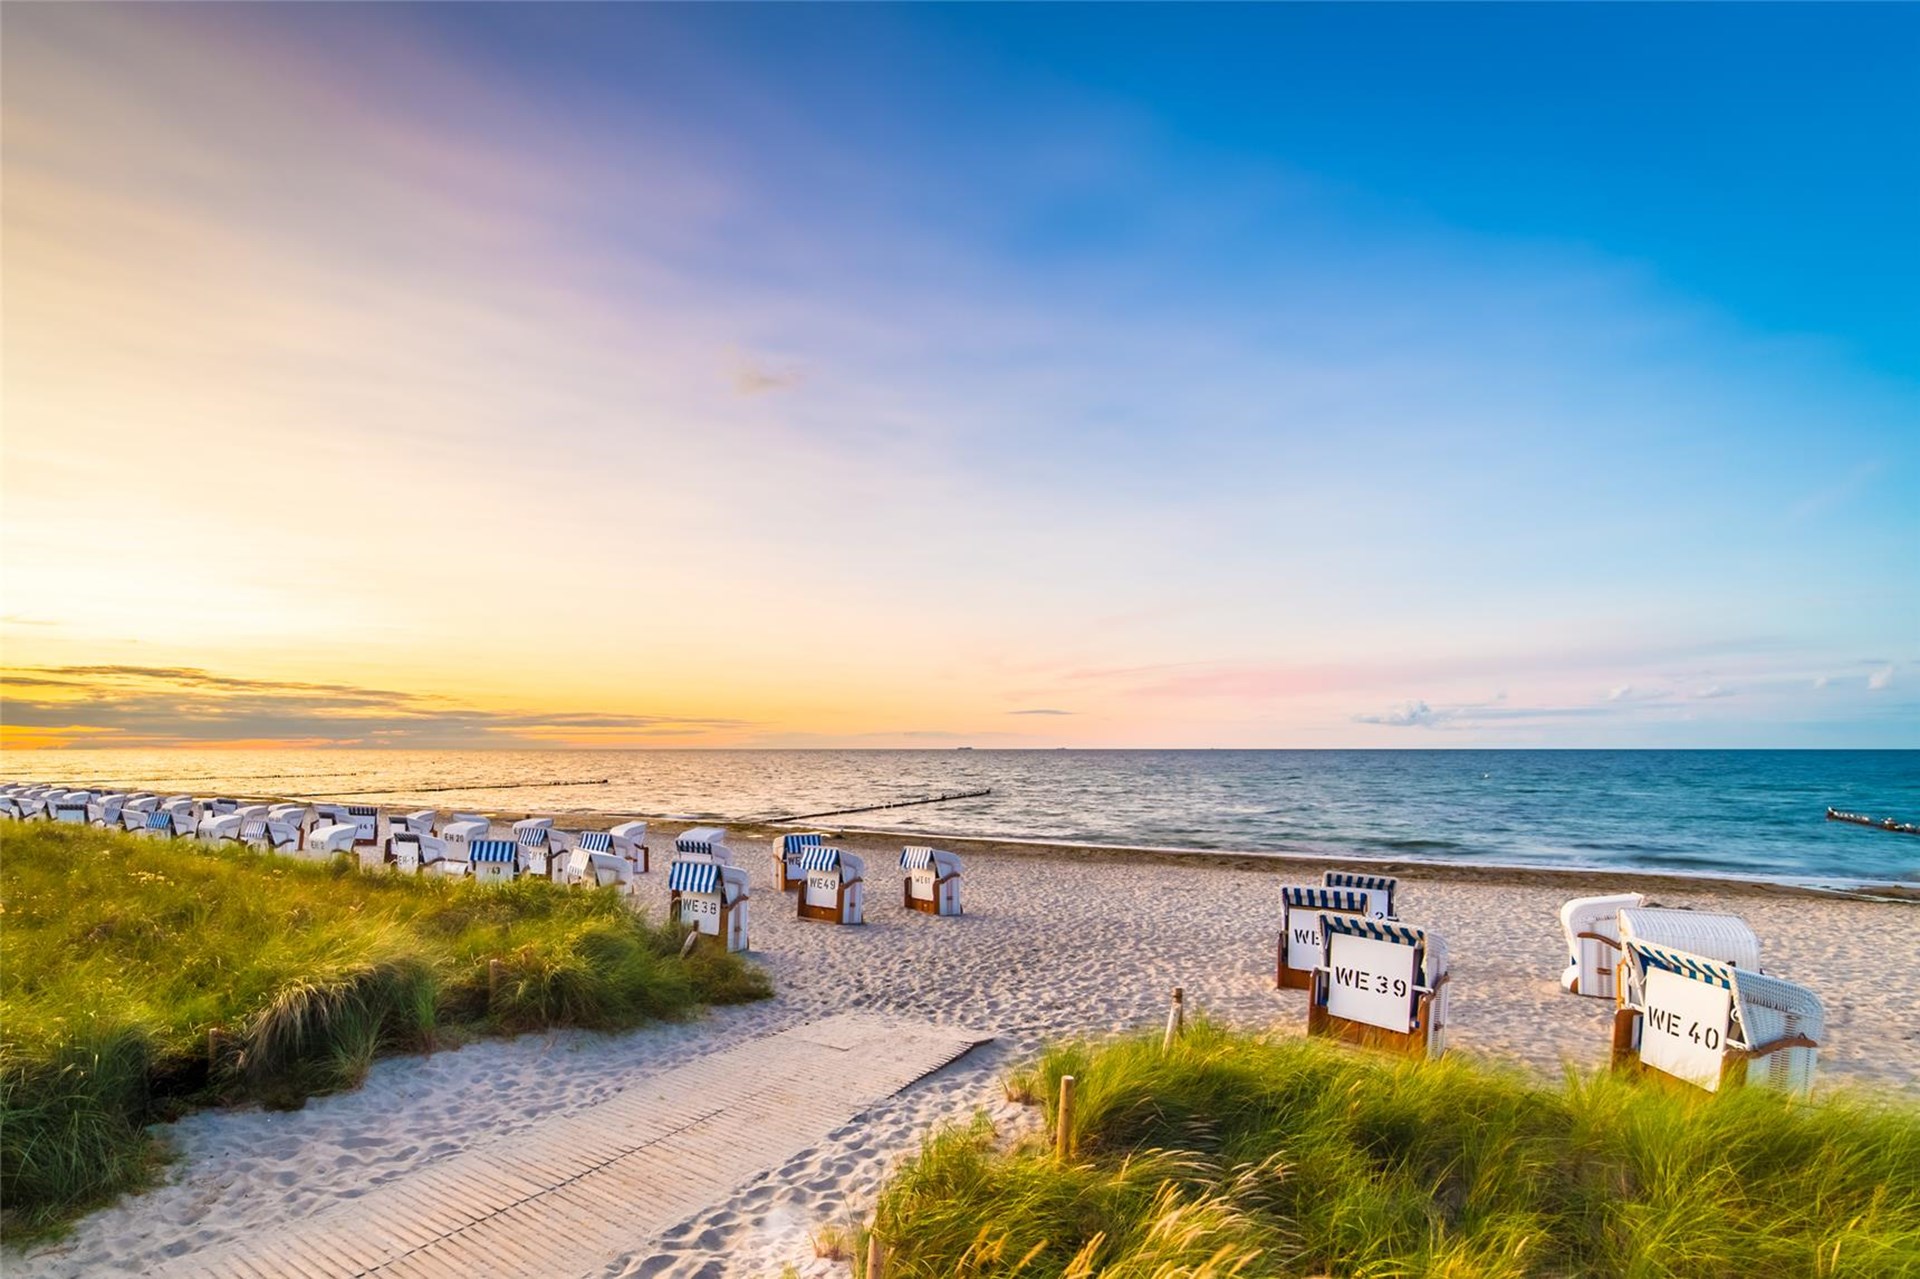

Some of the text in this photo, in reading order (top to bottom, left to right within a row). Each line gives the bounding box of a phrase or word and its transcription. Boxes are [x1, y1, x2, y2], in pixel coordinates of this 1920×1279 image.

[1294, 928, 1321, 946] WE
[1335, 965, 1407, 998] WE 39
[1648, 1005, 1719, 1050] WE 40
